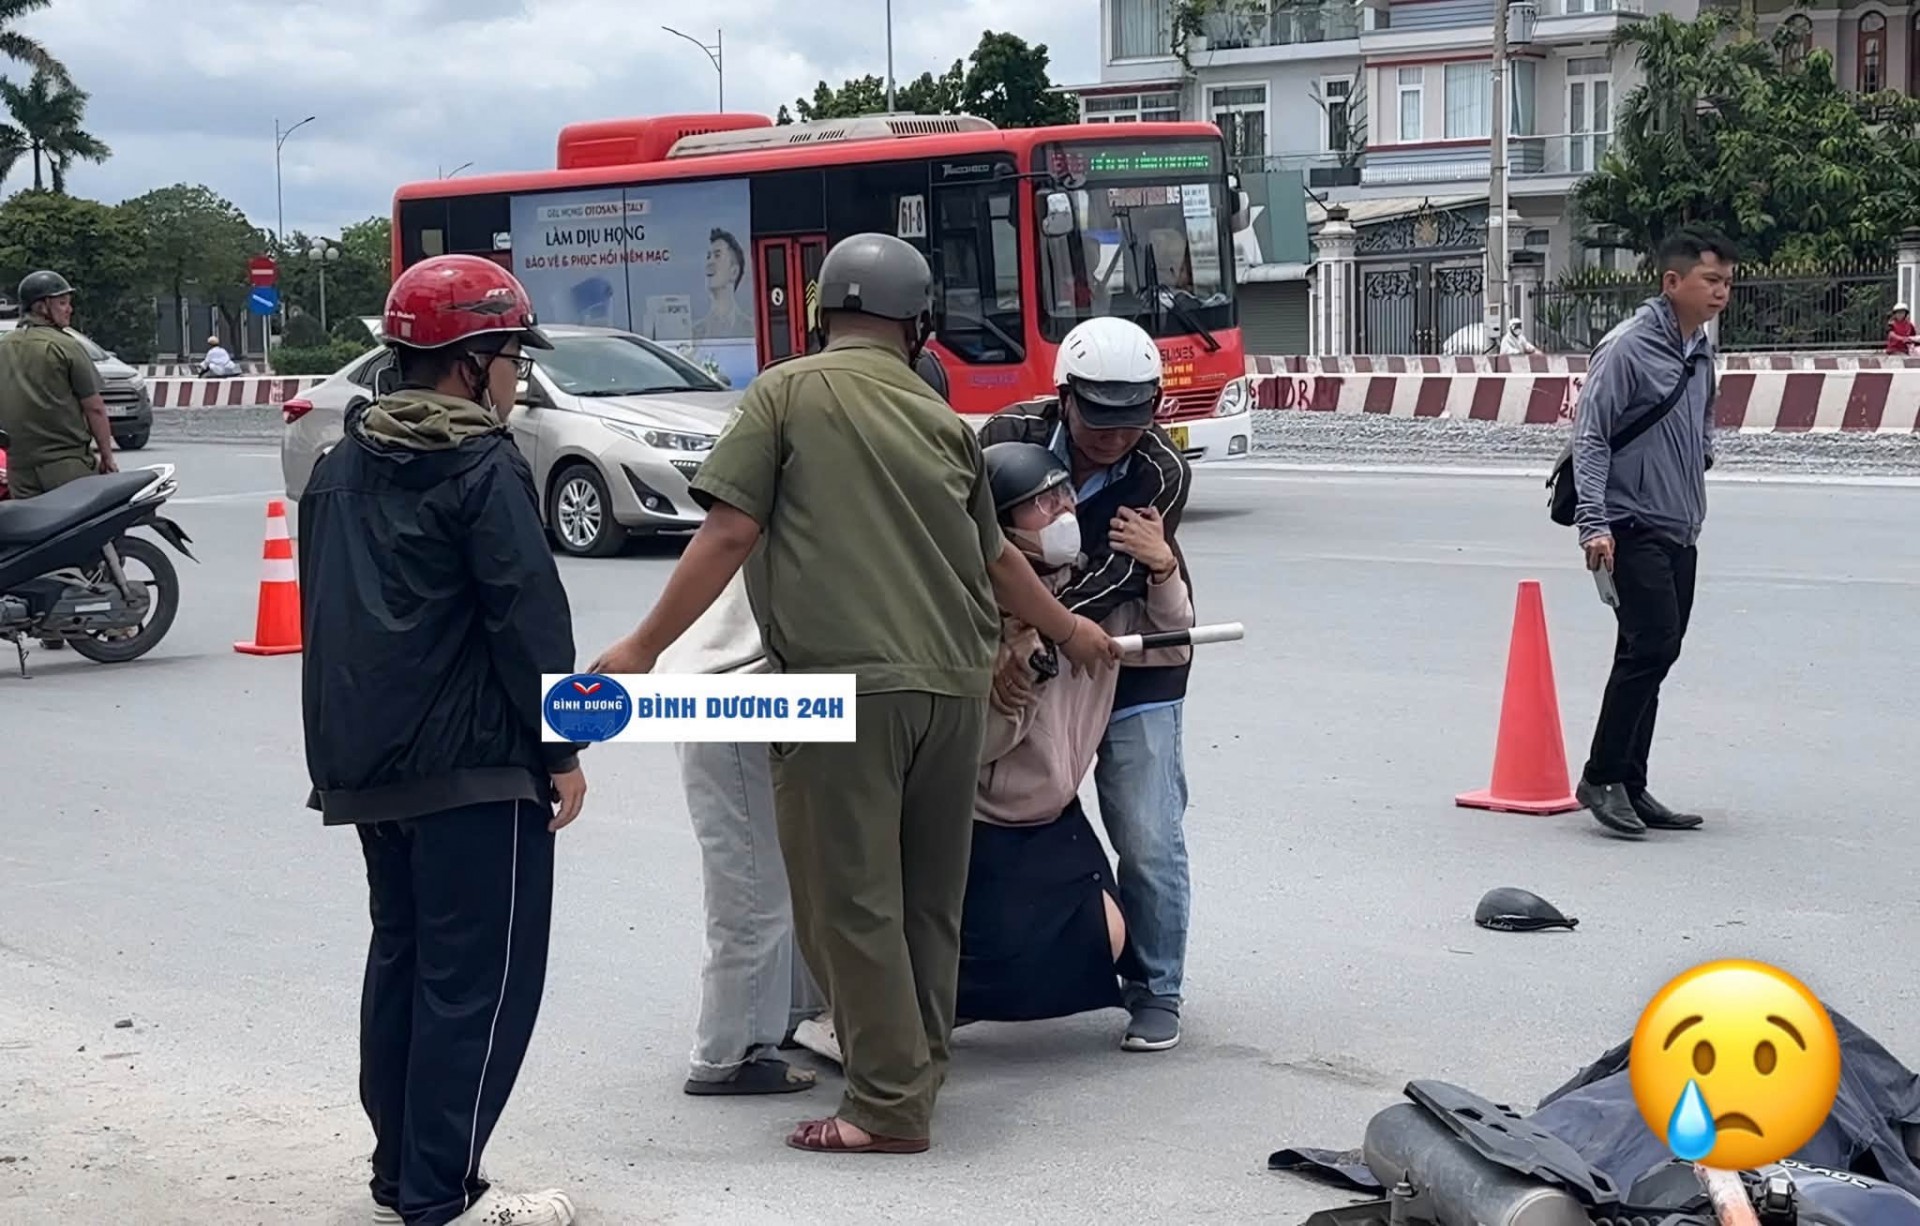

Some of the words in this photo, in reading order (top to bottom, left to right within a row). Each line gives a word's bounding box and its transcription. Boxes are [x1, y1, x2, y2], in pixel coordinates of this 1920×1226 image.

[901, 200, 923, 234] 61-8
[545, 226, 574, 246] LÀM
[576, 229, 600, 247] DỊU
[603, 225, 645, 246] HỌNG
